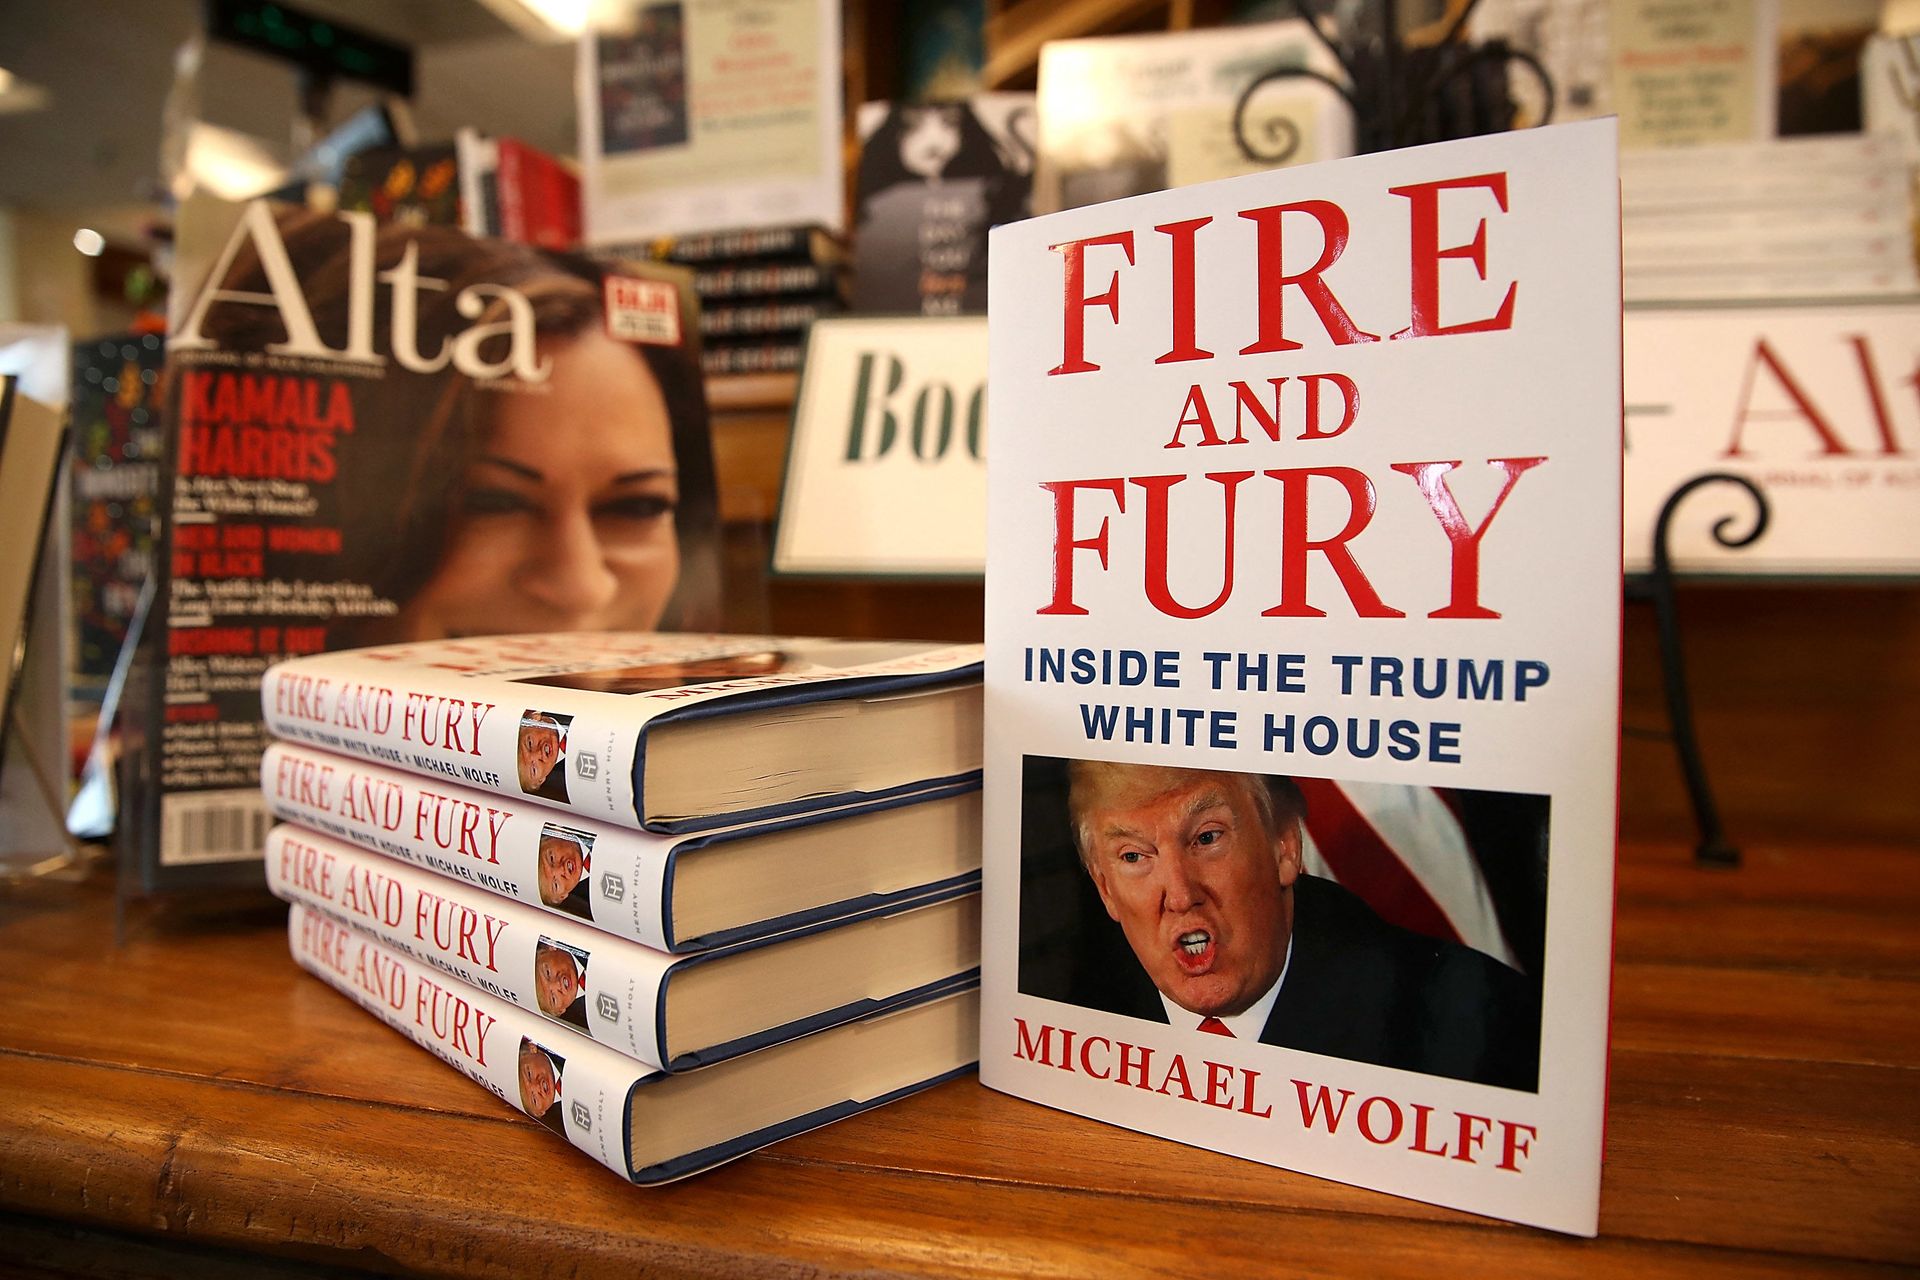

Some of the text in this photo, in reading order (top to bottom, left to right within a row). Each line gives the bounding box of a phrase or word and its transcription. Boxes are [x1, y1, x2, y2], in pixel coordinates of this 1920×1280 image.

[168, 199, 553, 384] Alta
[1047, 171, 1518, 376] FIRE
[182, 370, 355, 433] KAMALA
[1164, 373, 1360, 448] AND
[179, 425, 337, 484] HARRIS
[1036, 456, 1549, 620] FURY
[1025, 647, 1180, 688] INSIDE
[1203, 652, 1305, 693] THE
[1332, 655, 1550, 702] TRUMP
[276, 672, 496, 756] FIRE AND FURY
[1080, 704, 1461, 763] WHITE HOUSE
[371, 744, 402, 764] HOUSE
[413, 754, 461, 778] MICHAEL
[461, 766, 500, 788] WOLFF
[606, 732, 616, 811] HENRY HOLT
[277, 755, 514, 866] FIRE AND FURY
[280, 839, 510, 973] FIRE AND FURY
[379, 838, 413, 861] HOUSE
[426, 855, 477, 882] MICHAEL
[477, 872, 520, 897] WOLFF
[632, 855, 643, 935] HENRY HOLT
[301, 908, 350, 977] FIRE
[352, 944, 406, 1011] AND
[415, 975, 497, 1068] FURY
[426, 953, 477, 986] MICHAEL
[477, 976, 520, 1005] WOLFF
[627, 978, 636, 1010] HOLT
[467, 1068, 506, 1098] WOLFF
[1013, 1017, 1537, 1173] MICHAEL WOLFF
